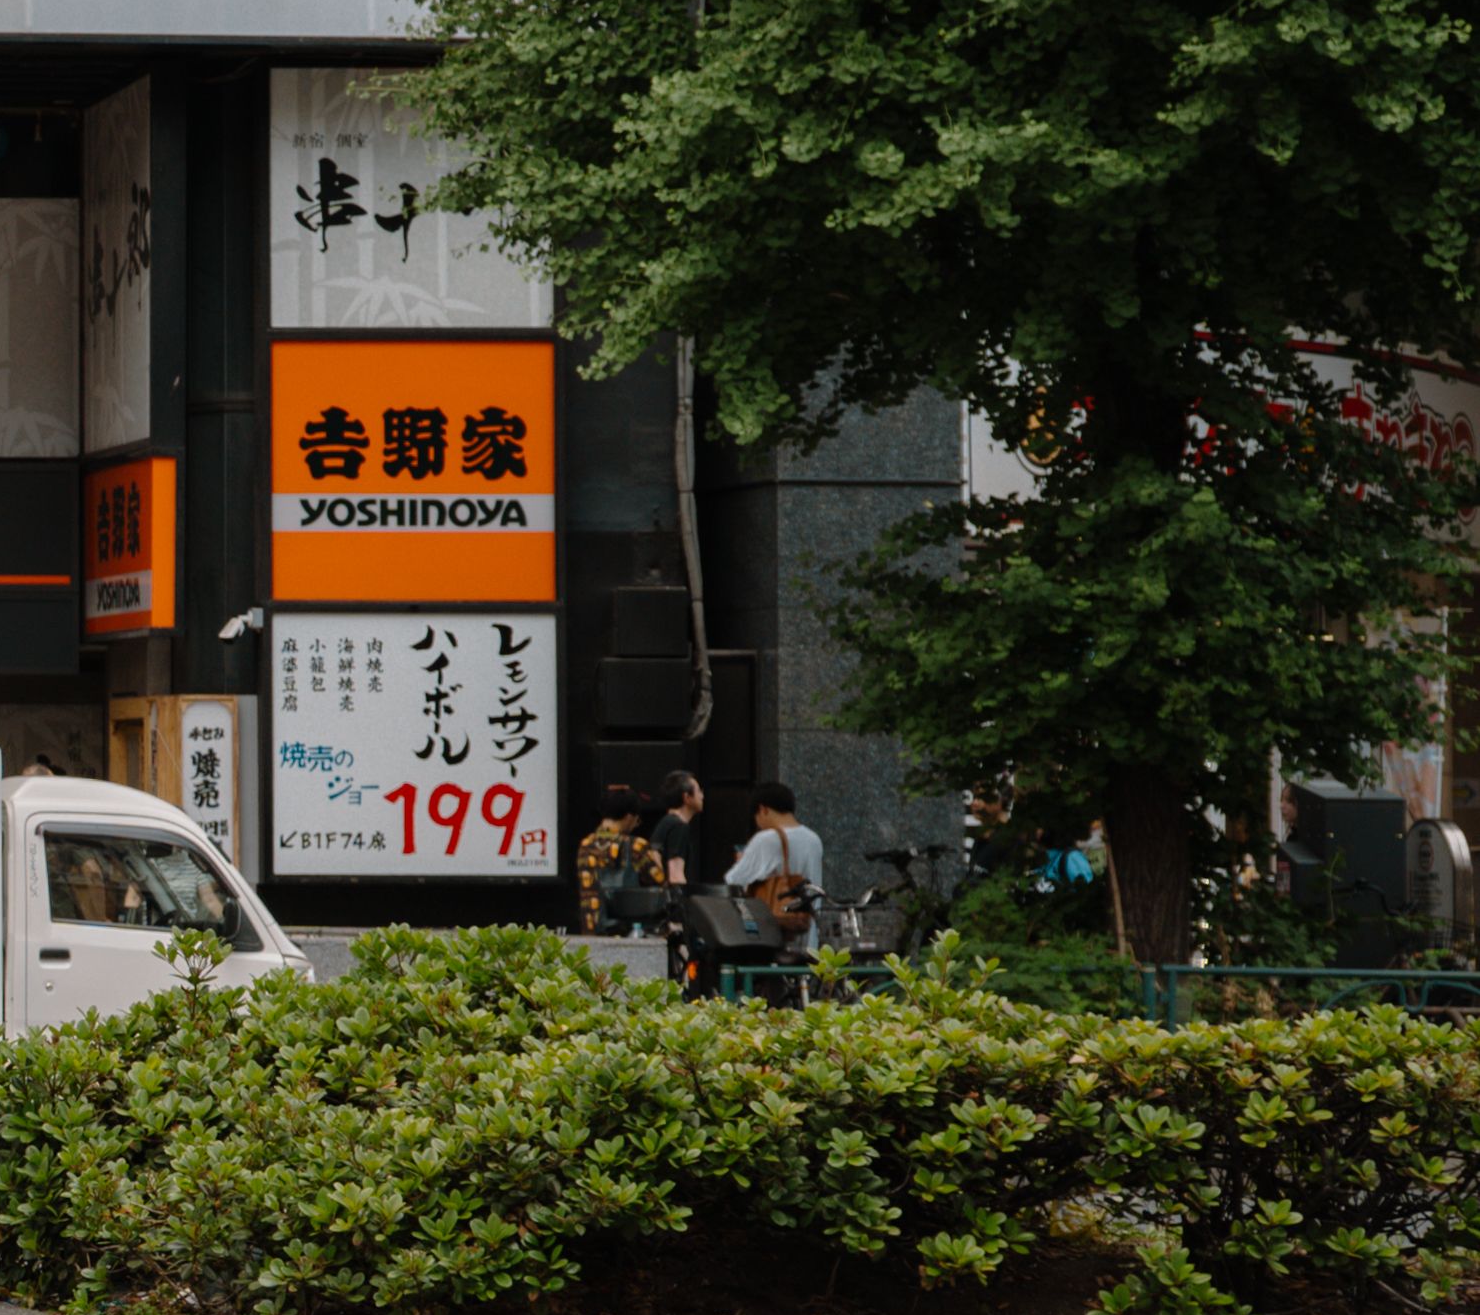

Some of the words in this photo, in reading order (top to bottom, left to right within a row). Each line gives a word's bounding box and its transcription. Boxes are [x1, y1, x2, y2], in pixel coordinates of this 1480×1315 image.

[300, 406, 529, 482] 吉野家
[299, 497, 529, 529] YOSHINOYA
[409, 624, 472, 767] ハイボール
[487, 623, 541, 778] レモンサワー
[279, 740, 355, 773] 焼売の
[327, 775, 380, 807] ジョー
